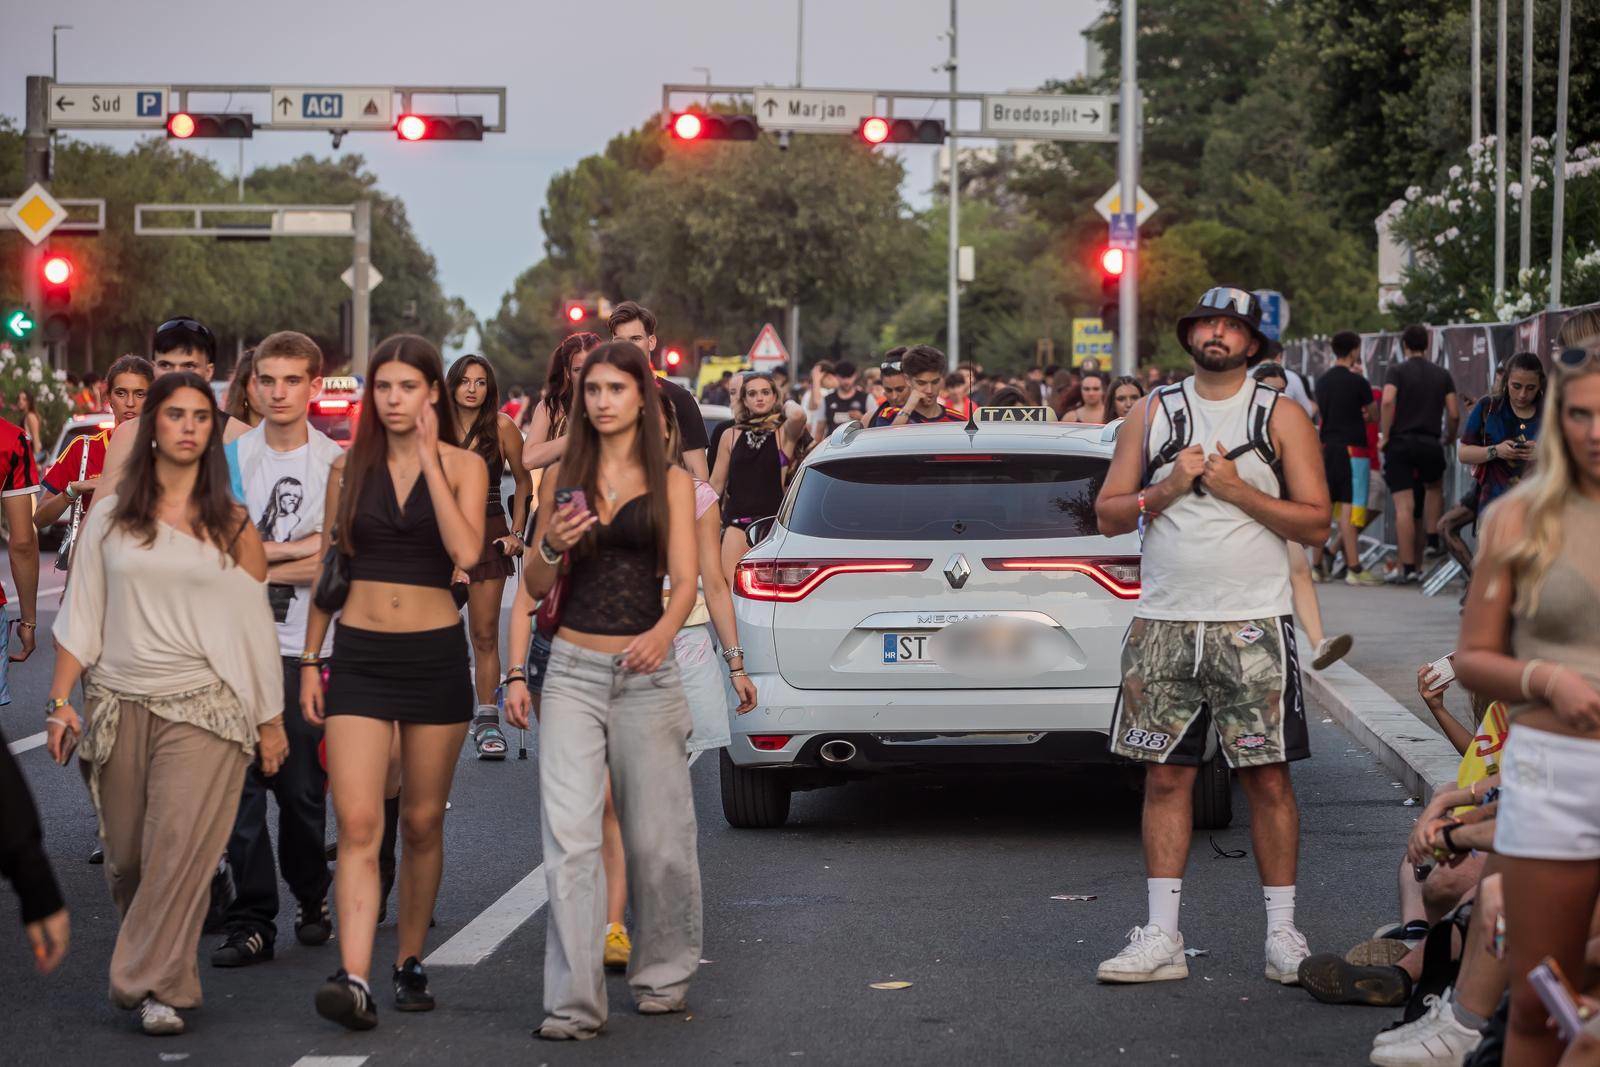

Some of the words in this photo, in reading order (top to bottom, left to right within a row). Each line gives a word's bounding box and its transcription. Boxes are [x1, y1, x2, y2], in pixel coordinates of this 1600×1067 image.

[92, 95, 120, 112] Sud
[142, 95, 157, 114] P
[306, 96, 340, 116] ACI
[788, 100, 846, 120] Marjan
[993, 104, 1078, 125] Brodosplit
[984, 408, 1044, 422] TAXI
[884, 651, 896, 659] HR
[899, 636, 927, 660] ST
[1124, 727, 1170, 750] 88
